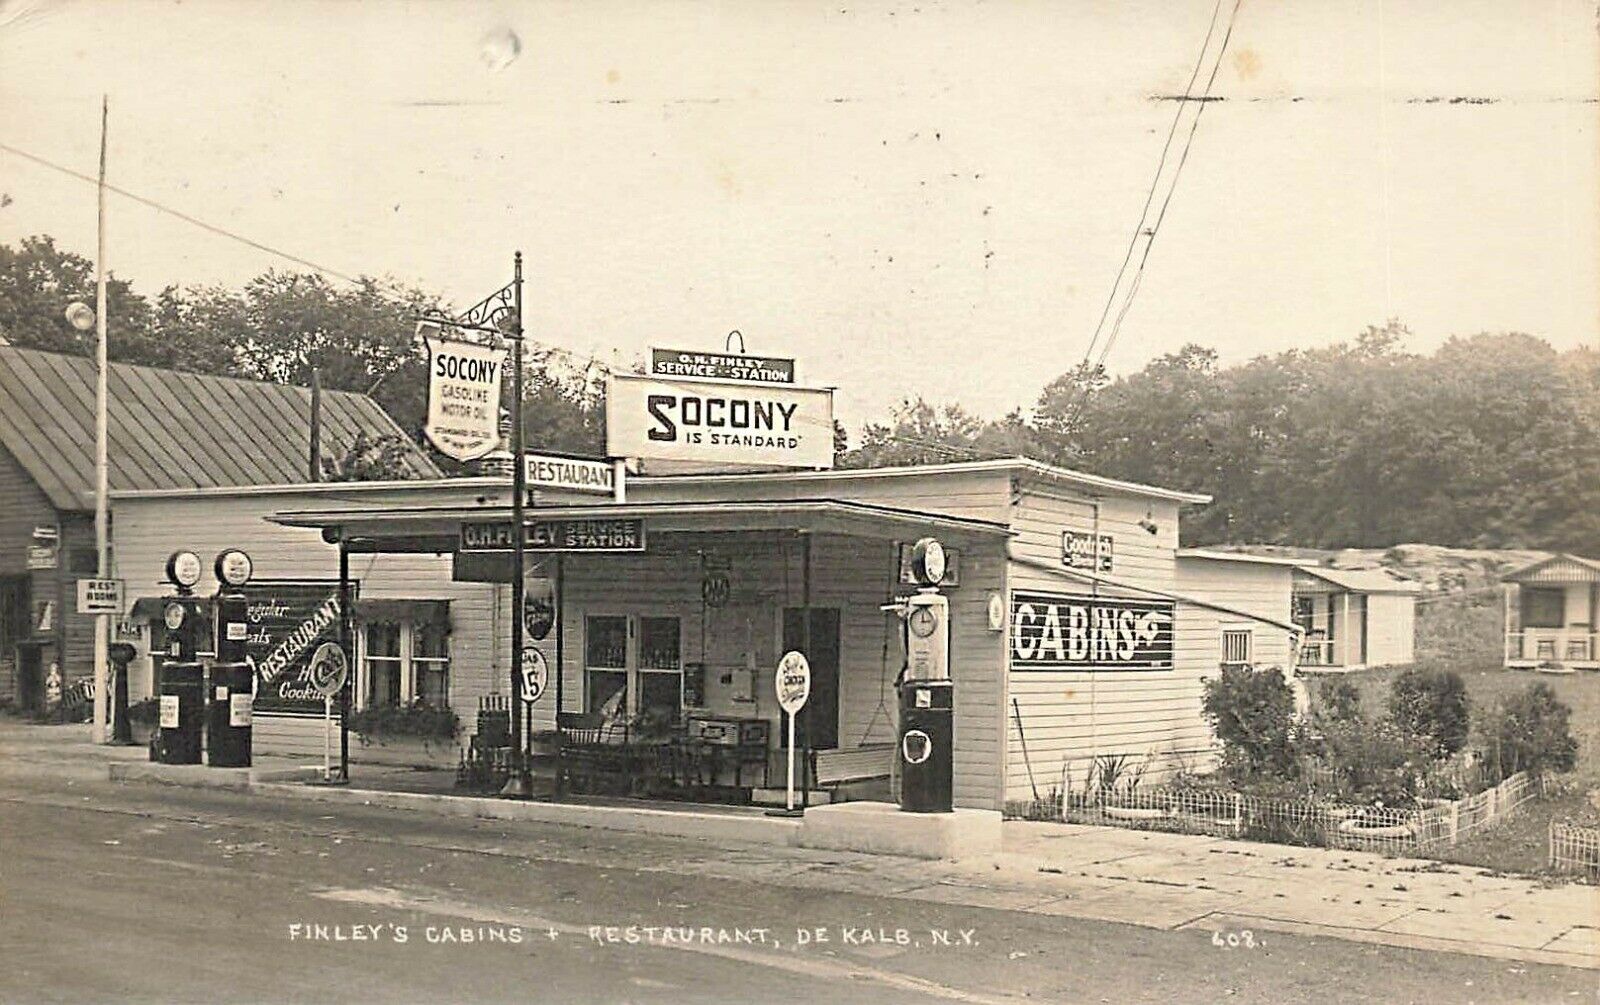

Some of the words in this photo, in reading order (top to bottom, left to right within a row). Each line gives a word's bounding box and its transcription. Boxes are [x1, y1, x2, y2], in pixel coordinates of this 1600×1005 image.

[436, 353, 498, 385] SOCONY
[656, 361, 716, 377] SERVICE
[730, 367, 789, 382] STATION
[647, 394, 798, 442] SOCONY
[686, 432, 702, 444] IS
[527, 454, 615, 492] RESTAURANT
[566, 534, 637, 547] STATION
[247, 598, 290, 623] egular
[246, 626, 273, 645] eals
[258, 593, 342, 683] RESTAURANT
[1014, 603, 1136, 661] CABINS
